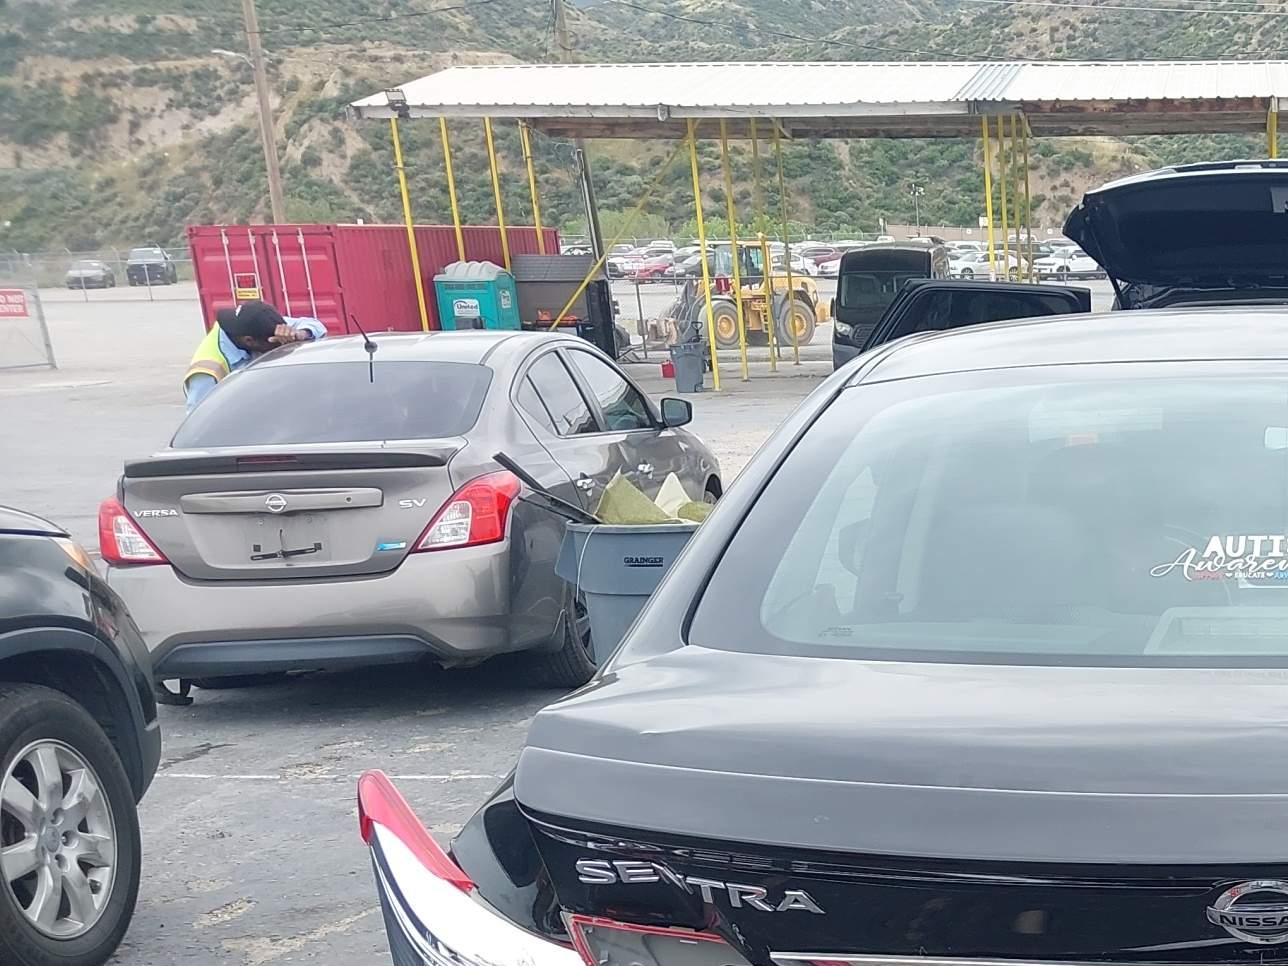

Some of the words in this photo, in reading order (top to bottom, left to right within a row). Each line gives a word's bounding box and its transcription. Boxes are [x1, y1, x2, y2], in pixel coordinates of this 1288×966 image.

[399, 498, 427, 509] SV
[133, 508, 178, 518] VERSA
[623, 556, 664, 564] GRAINGER
[574, 857, 827, 915] SENTRA
